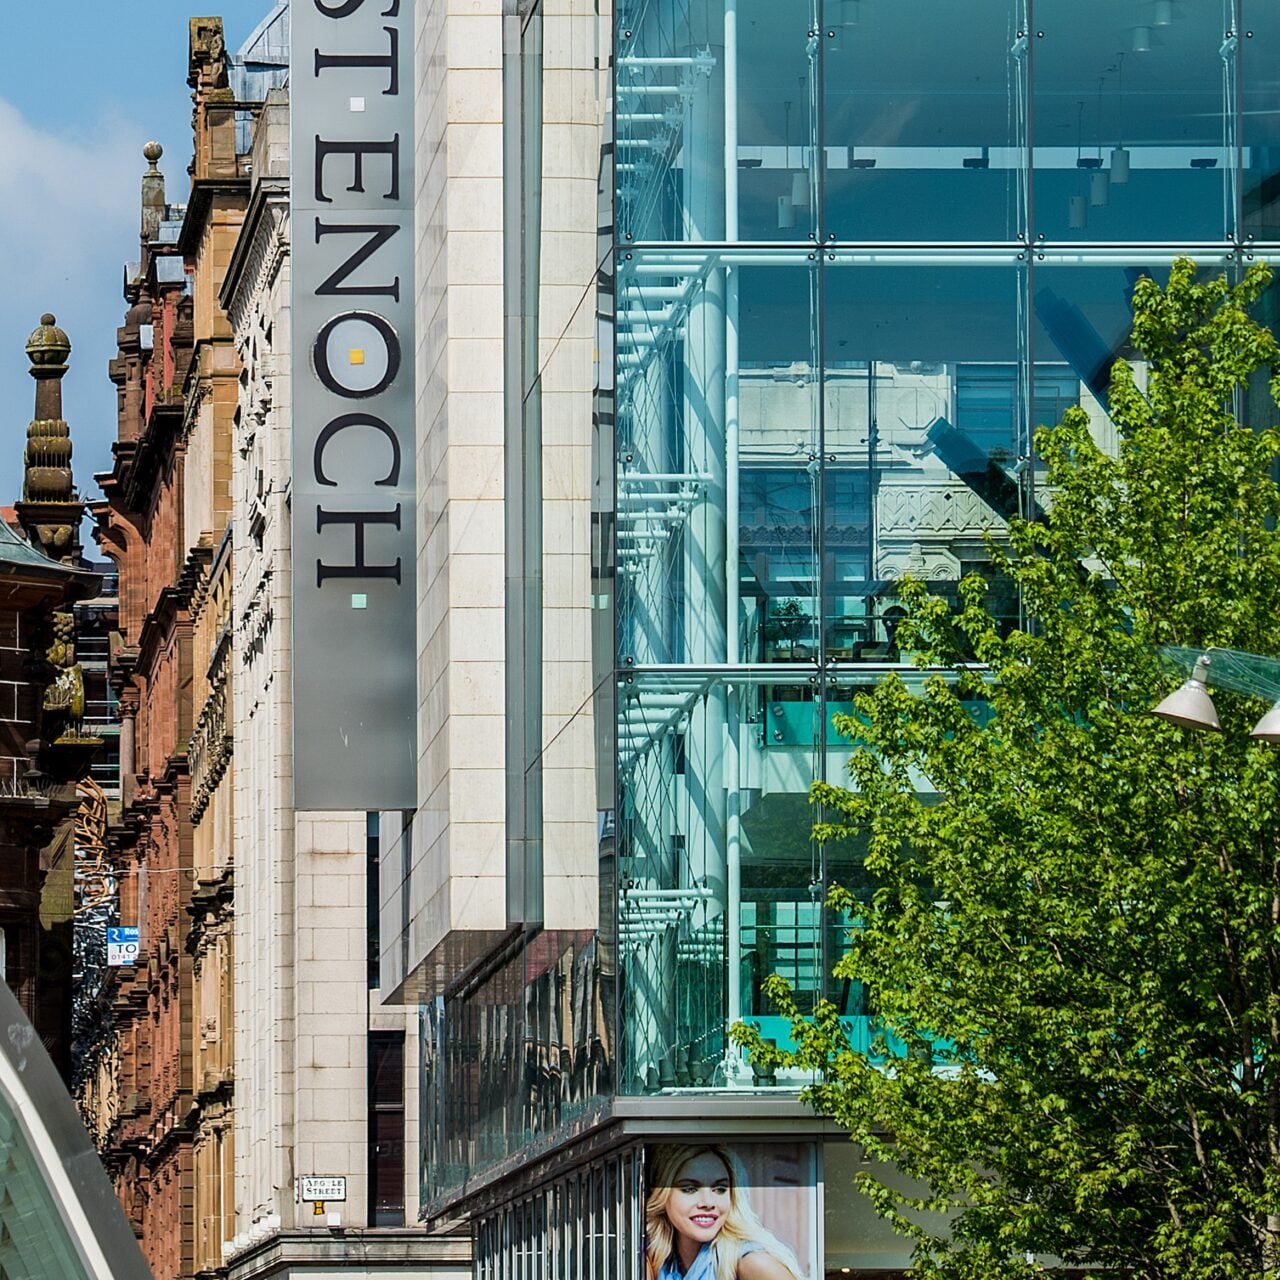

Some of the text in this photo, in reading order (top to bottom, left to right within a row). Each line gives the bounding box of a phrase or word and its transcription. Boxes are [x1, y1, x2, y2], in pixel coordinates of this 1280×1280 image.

[313, 132, 402, 589] ENOCH
[116, 943, 137, 954] TO
[306, 1187, 342, 1195] STREET
